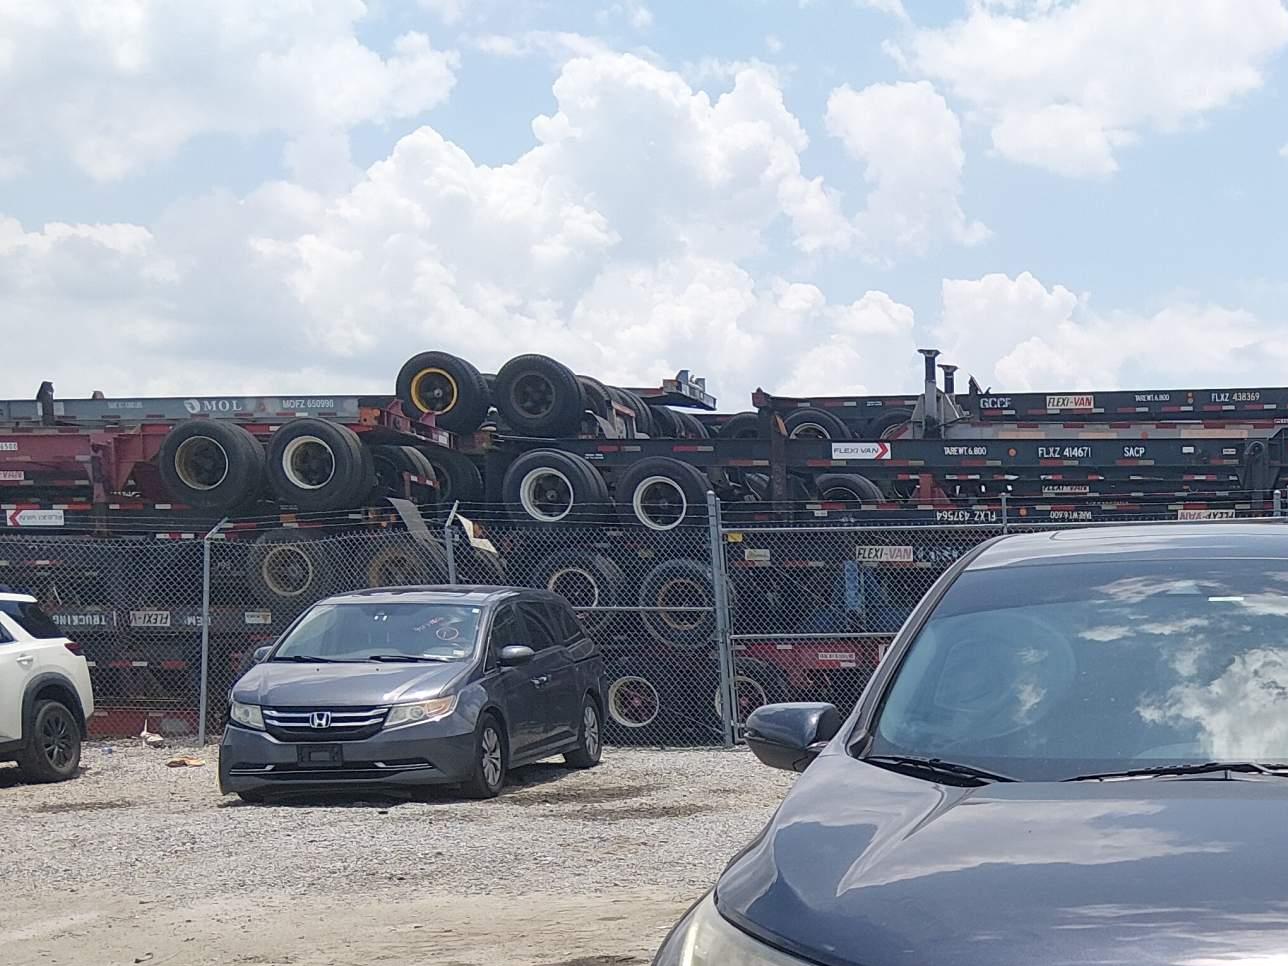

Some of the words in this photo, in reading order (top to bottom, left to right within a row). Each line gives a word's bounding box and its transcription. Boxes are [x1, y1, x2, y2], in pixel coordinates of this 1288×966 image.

[1211, 393, 1229, 402] FLXZ
[1232, 392, 1260, 401] 438369
[204, 400, 242, 411] MOL
[1047, 397, 1092, 408] FLEXI-VAN
[1038, 447, 1060, 457] FLXZ
[1063, 447, 1091, 457] 414671
[1124, 447, 1146, 457] SACP
[936, 511, 970, 521] 437564
[974, 511, 996, 521] FLXZ
[857, 547, 912, 560] FLEXI-VAN
[53, 614, 107, 625] TRUCKING
